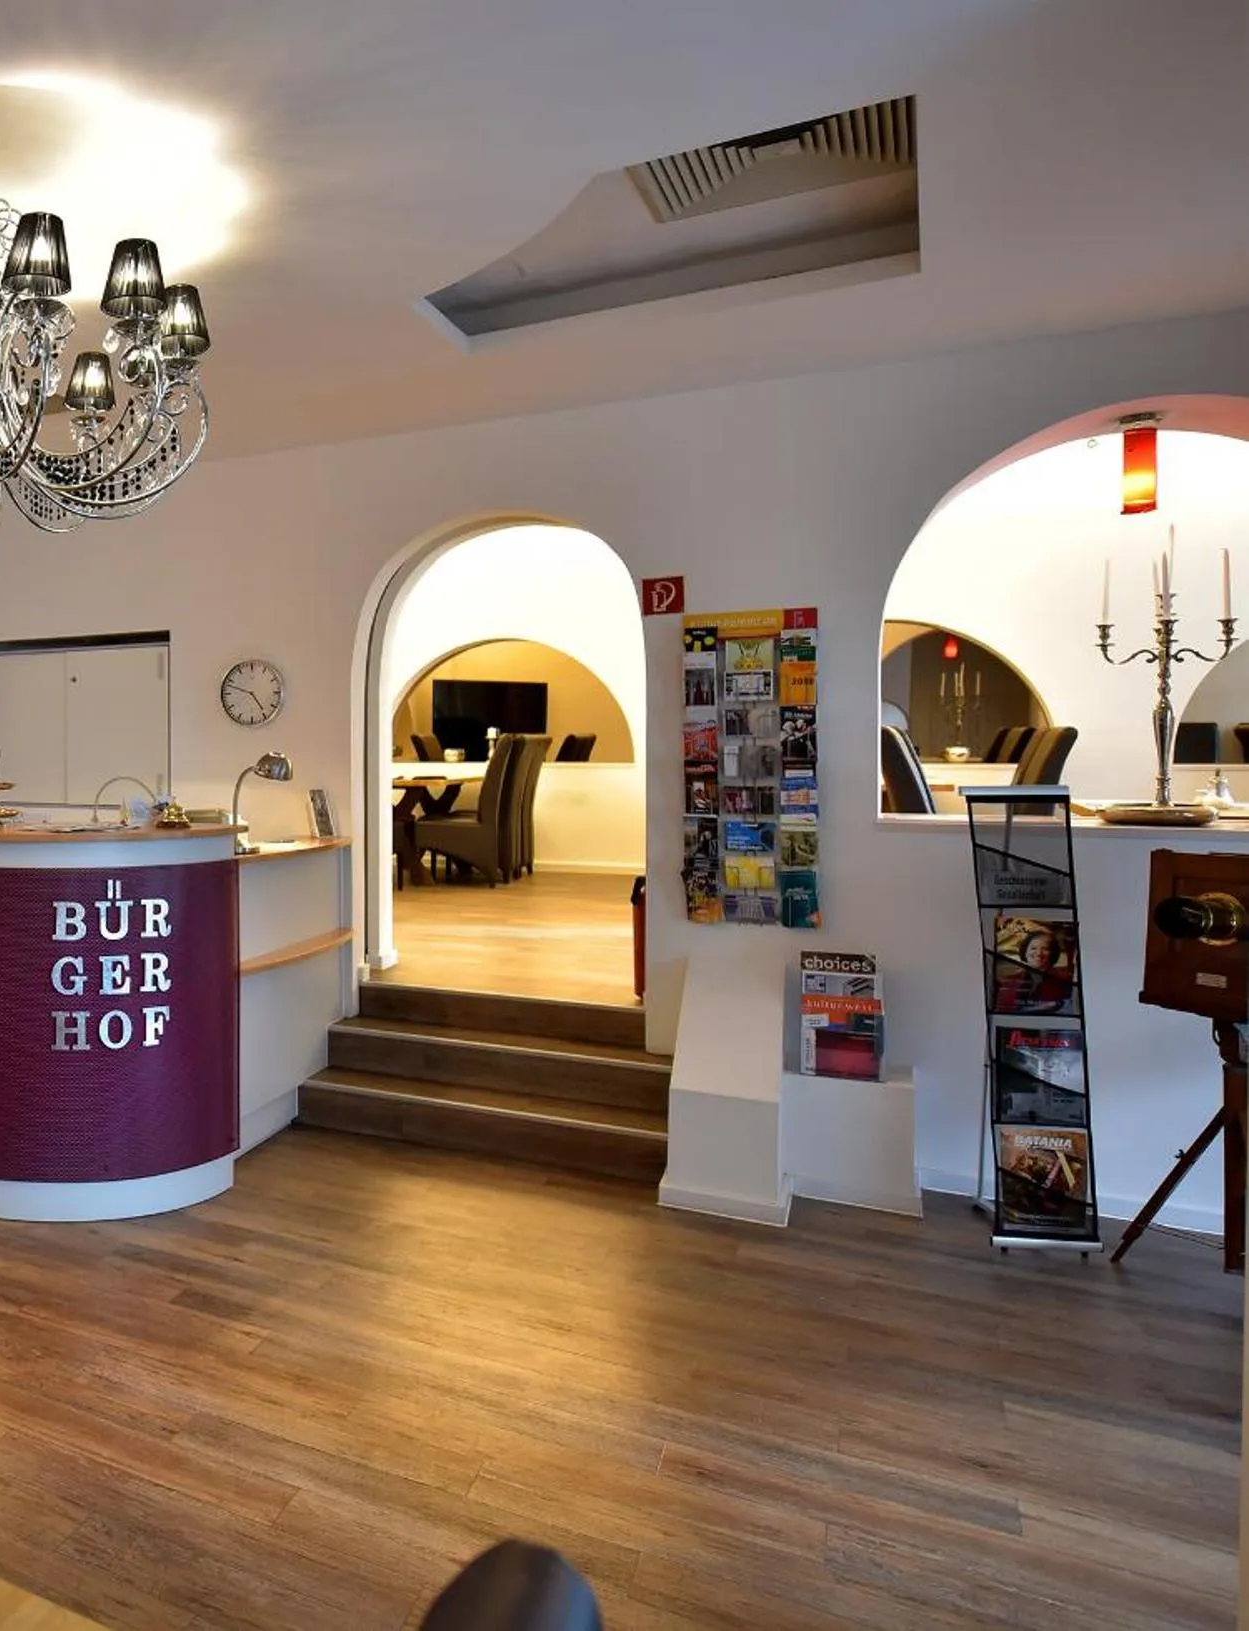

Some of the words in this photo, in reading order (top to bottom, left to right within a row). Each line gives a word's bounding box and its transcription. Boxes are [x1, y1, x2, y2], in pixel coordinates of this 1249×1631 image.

[52, 879, 172, 941] BÜR
[51, 952, 172, 996] GER
[804, 955, 872, 973] choices
[51, 1006, 170, 1051] HOF
